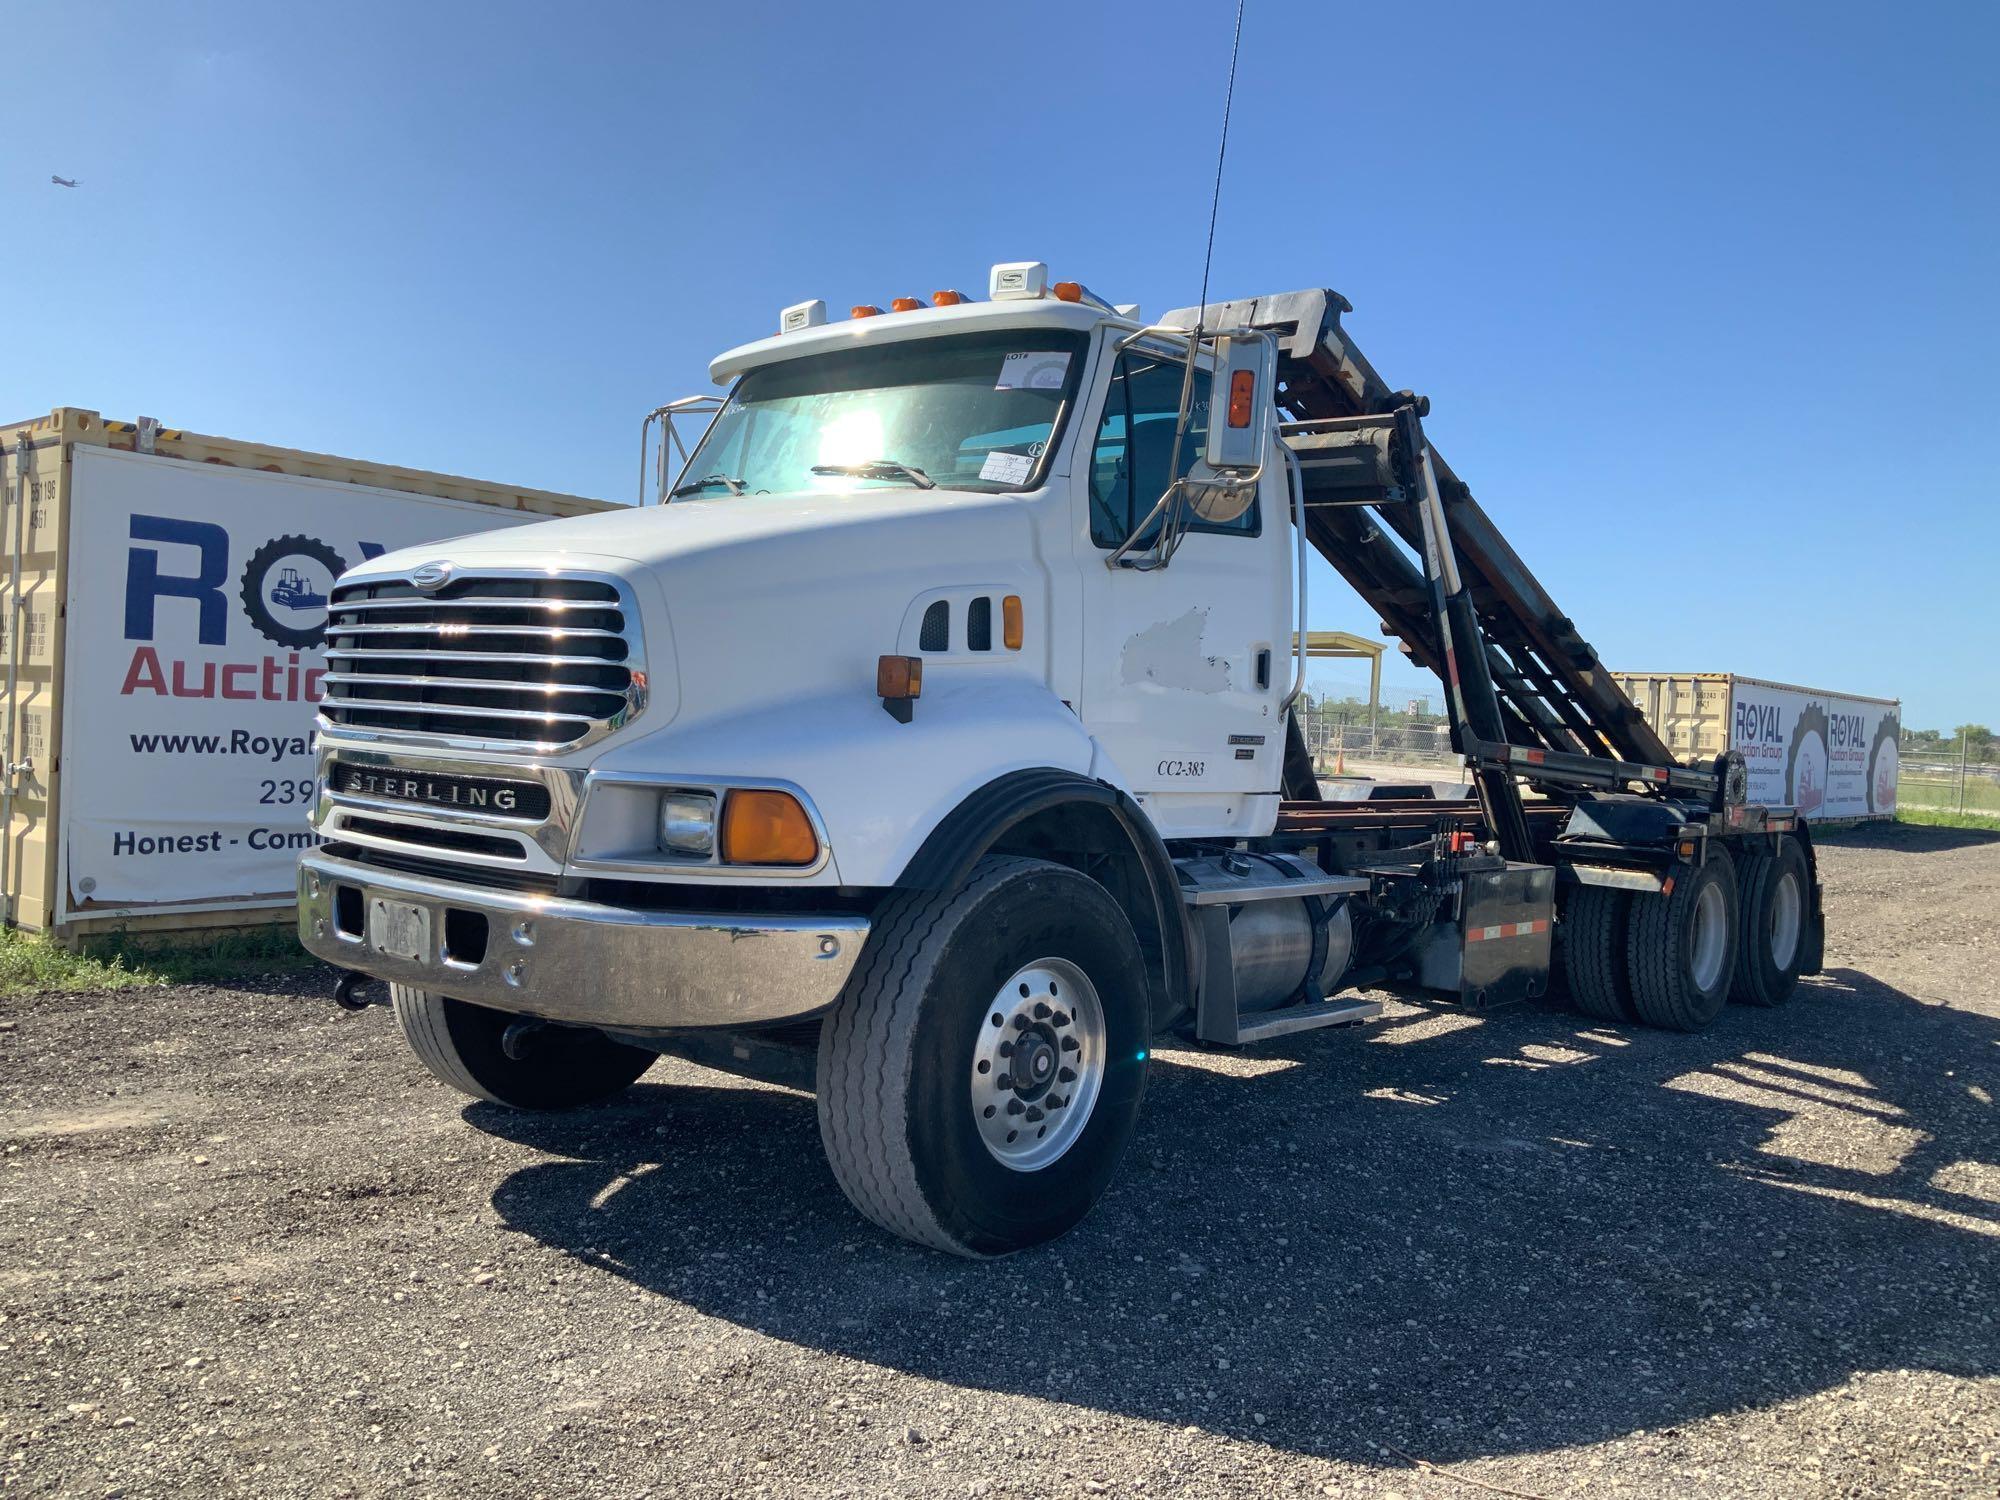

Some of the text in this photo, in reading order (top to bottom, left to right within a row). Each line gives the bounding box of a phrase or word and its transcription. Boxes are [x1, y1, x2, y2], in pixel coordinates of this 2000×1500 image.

[1006, 353, 1029, 361] LOT#
[1735, 702, 1783, 743] ROYAL
[1830, 714, 1866, 748] ROYAL
[1762, 744, 1783, 761] Group
[1157, 760, 1205, 776] CC2-383
[259, 780, 314, 804] 239
[351, 772, 516, 810] STERLING
[113, 829, 222, 856] Honest
